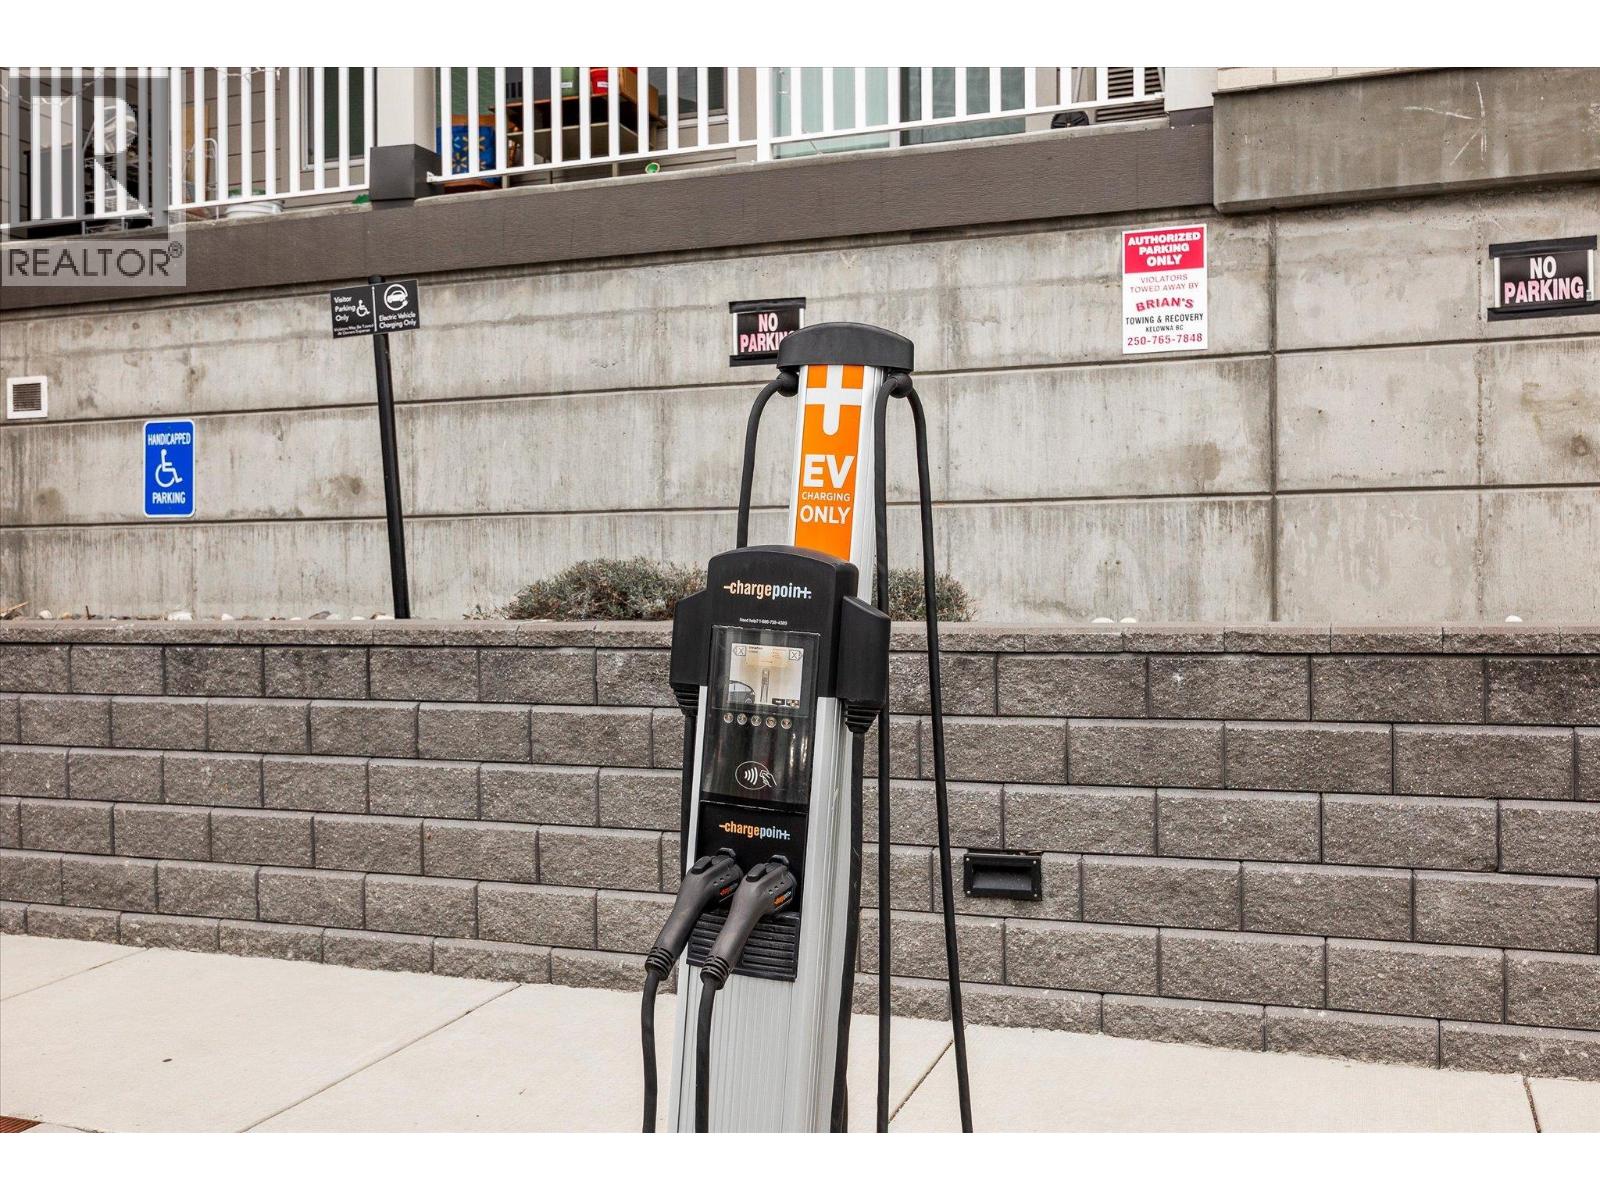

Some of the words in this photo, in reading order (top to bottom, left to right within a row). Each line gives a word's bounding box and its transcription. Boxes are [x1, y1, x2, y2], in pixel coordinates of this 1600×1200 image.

[1128, 232, 1201, 246] AUTHORIZED
[1139, 243, 1189, 255] PARKING
[1147, 254, 1182, 267] ONLY
[1530, 256, 1557, 279] NO
[1140, 274, 1188, 283] VIOLATORS
[1130, 285, 1160, 293] TOWED
[1163, 283, 1186, 291] AWAY
[1504, 276, 1584, 304] PARKING
[1136, 297, 1194, 312] BRIAN'S
[379, 321, 403, 329] Charging
[758, 312, 778, 332] NO
[1126, 315, 1154, 325] TOWING
[1157, 315, 1162, 323] &
[1165, 313, 1204, 322] RECOVERY
[740, 330, 795, 352] PARKI
[1127, 333, 1203, 346] 250-765-7848
[148, 432, 191, 446] HANDICAPPED
[803, 454, 855, 489] EV
[152, 492, 186, 504] PARKING
[802, 491, 850, 502] CHARGING
[800, 505, 850, 524] ONLY
